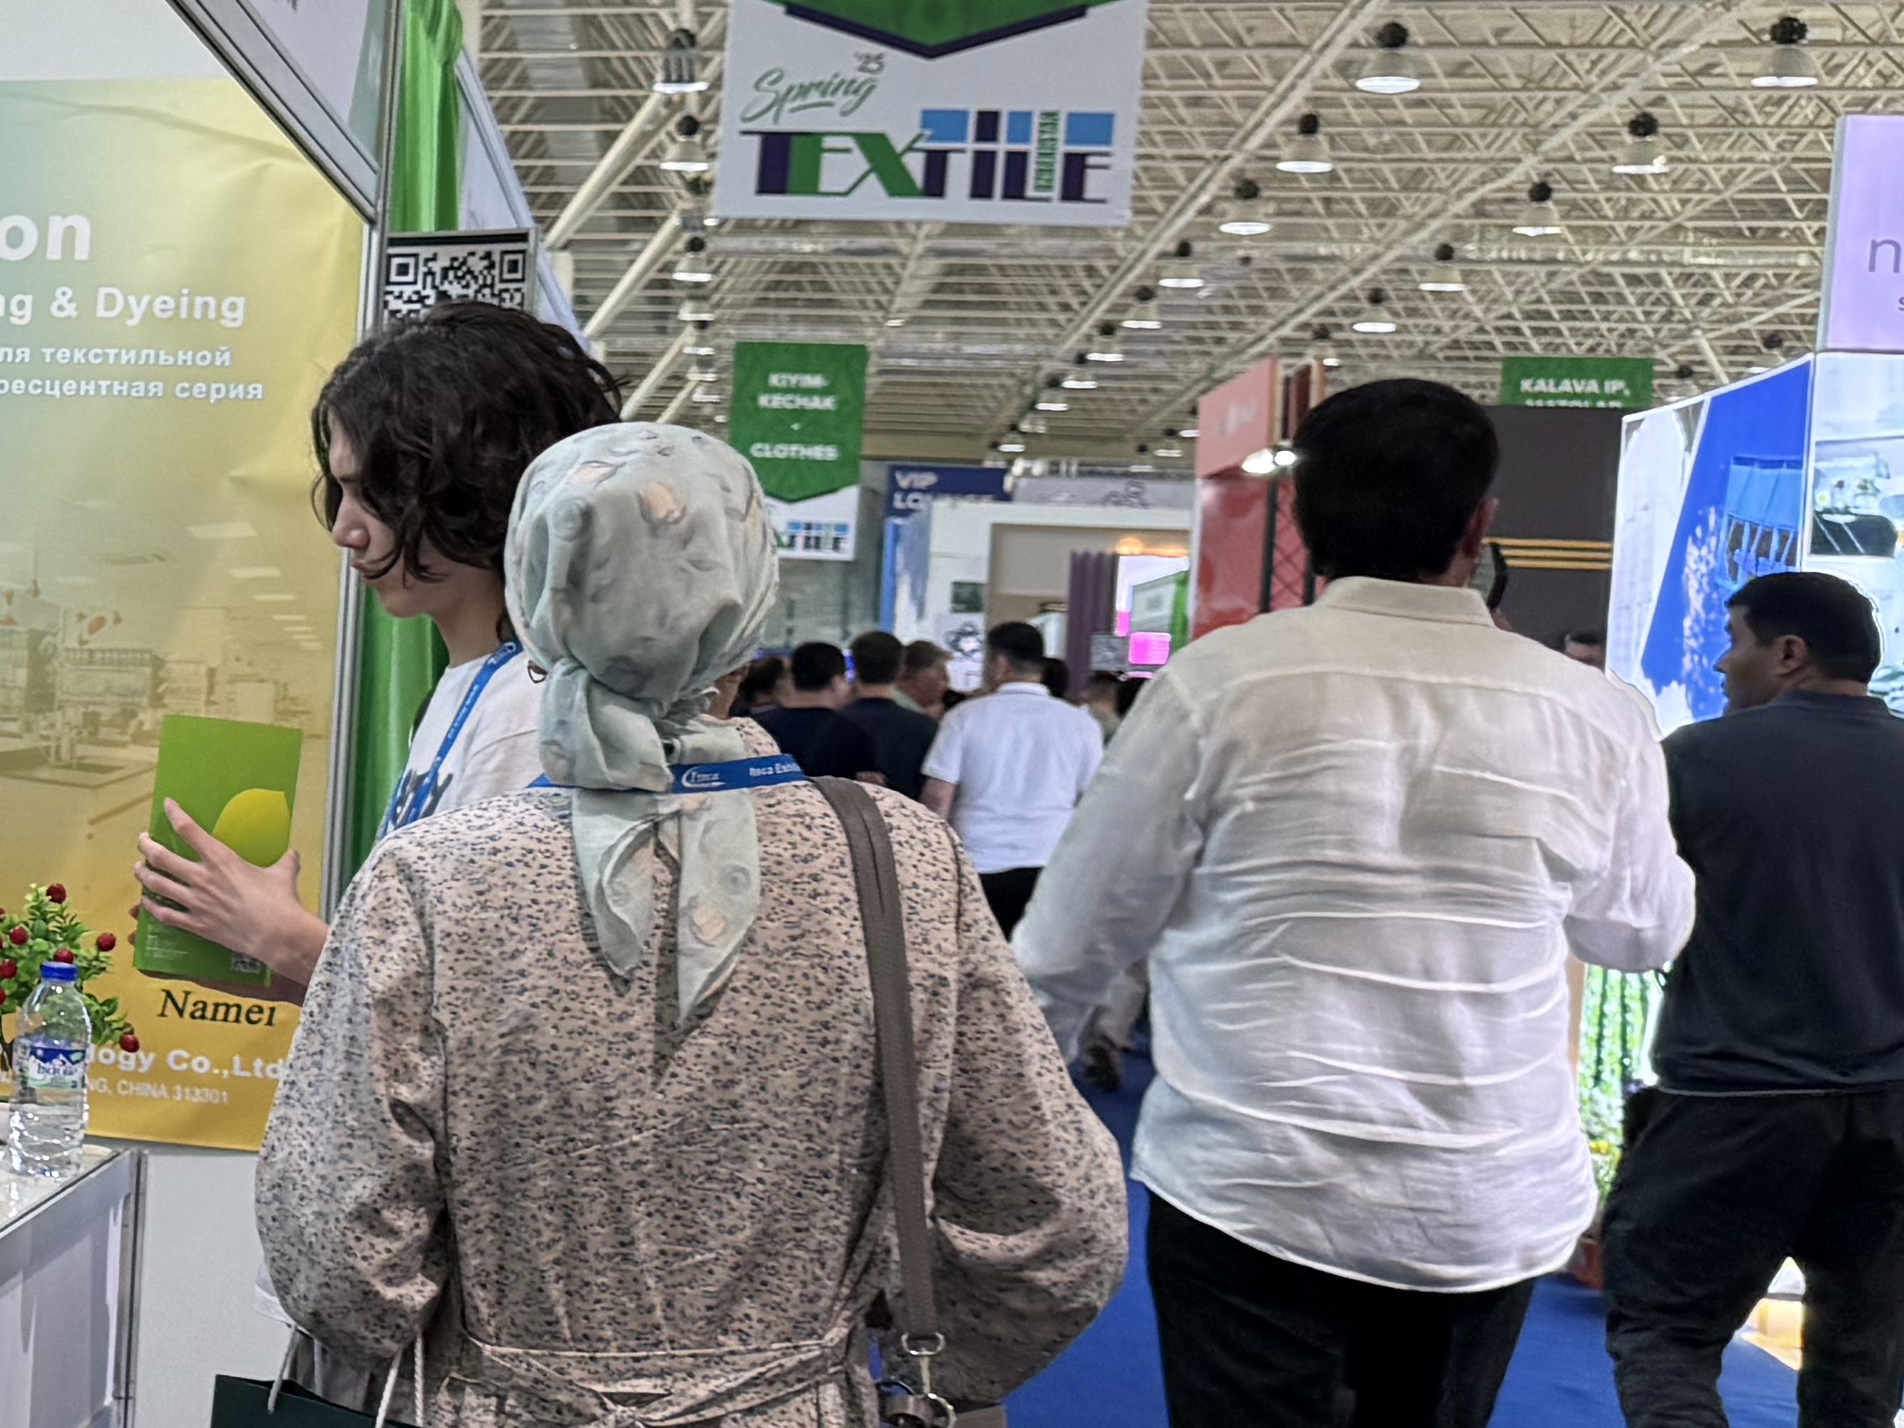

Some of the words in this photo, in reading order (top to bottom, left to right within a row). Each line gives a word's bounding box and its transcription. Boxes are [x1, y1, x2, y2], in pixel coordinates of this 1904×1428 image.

[740, 68, 881, 125] Spring
[50, 287, 78, 317] &
[95, 288, 246, 328] Dyeing
[42, 344, 231, 368] текстильной
[175, 380, 263, 403] серия
[1519, 378, 1601, 395] KALAVA
[749, 443, 839, 461] CLOTHES
[895, 470, 938, 489] VIP
